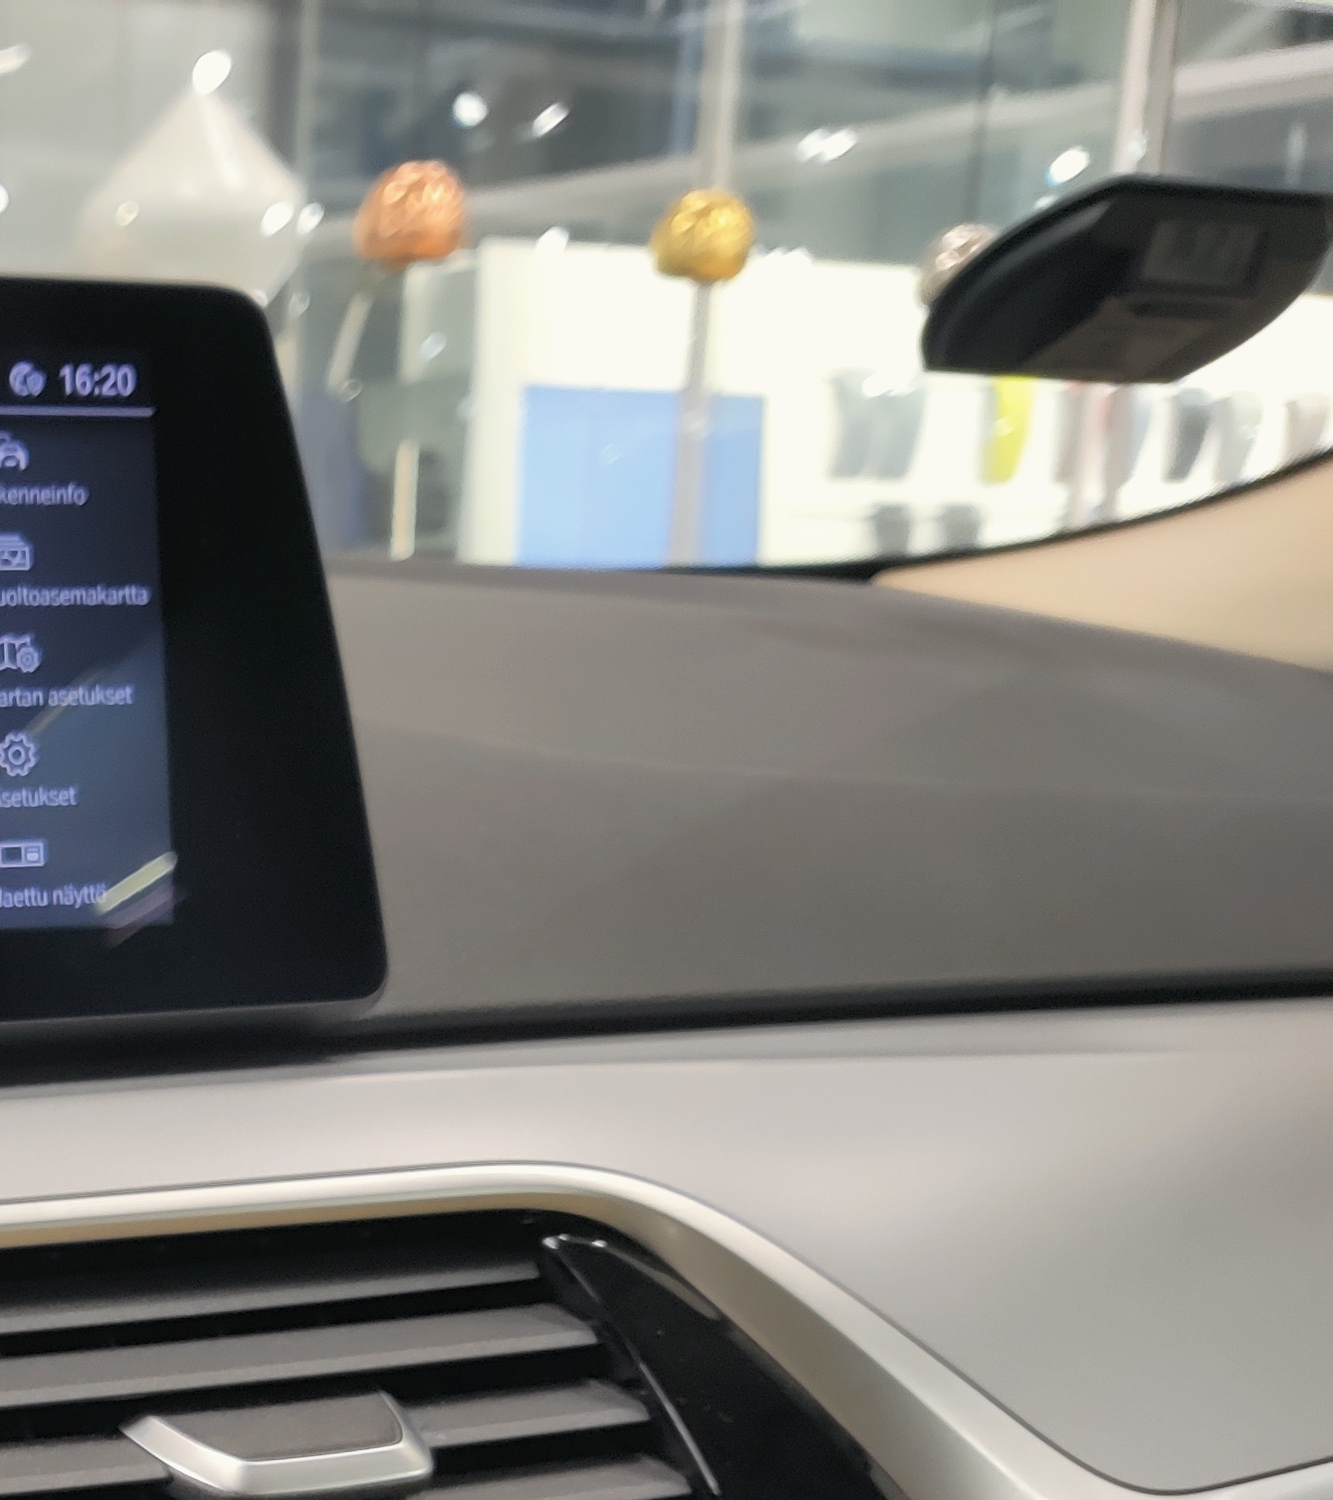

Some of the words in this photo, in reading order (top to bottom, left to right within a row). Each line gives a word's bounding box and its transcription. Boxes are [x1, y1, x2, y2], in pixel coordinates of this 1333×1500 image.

[59, 362, 136, 396] 16:20
[48, 684, 135, 705] asetukset
[52, 882, 110, 909] näyttö
